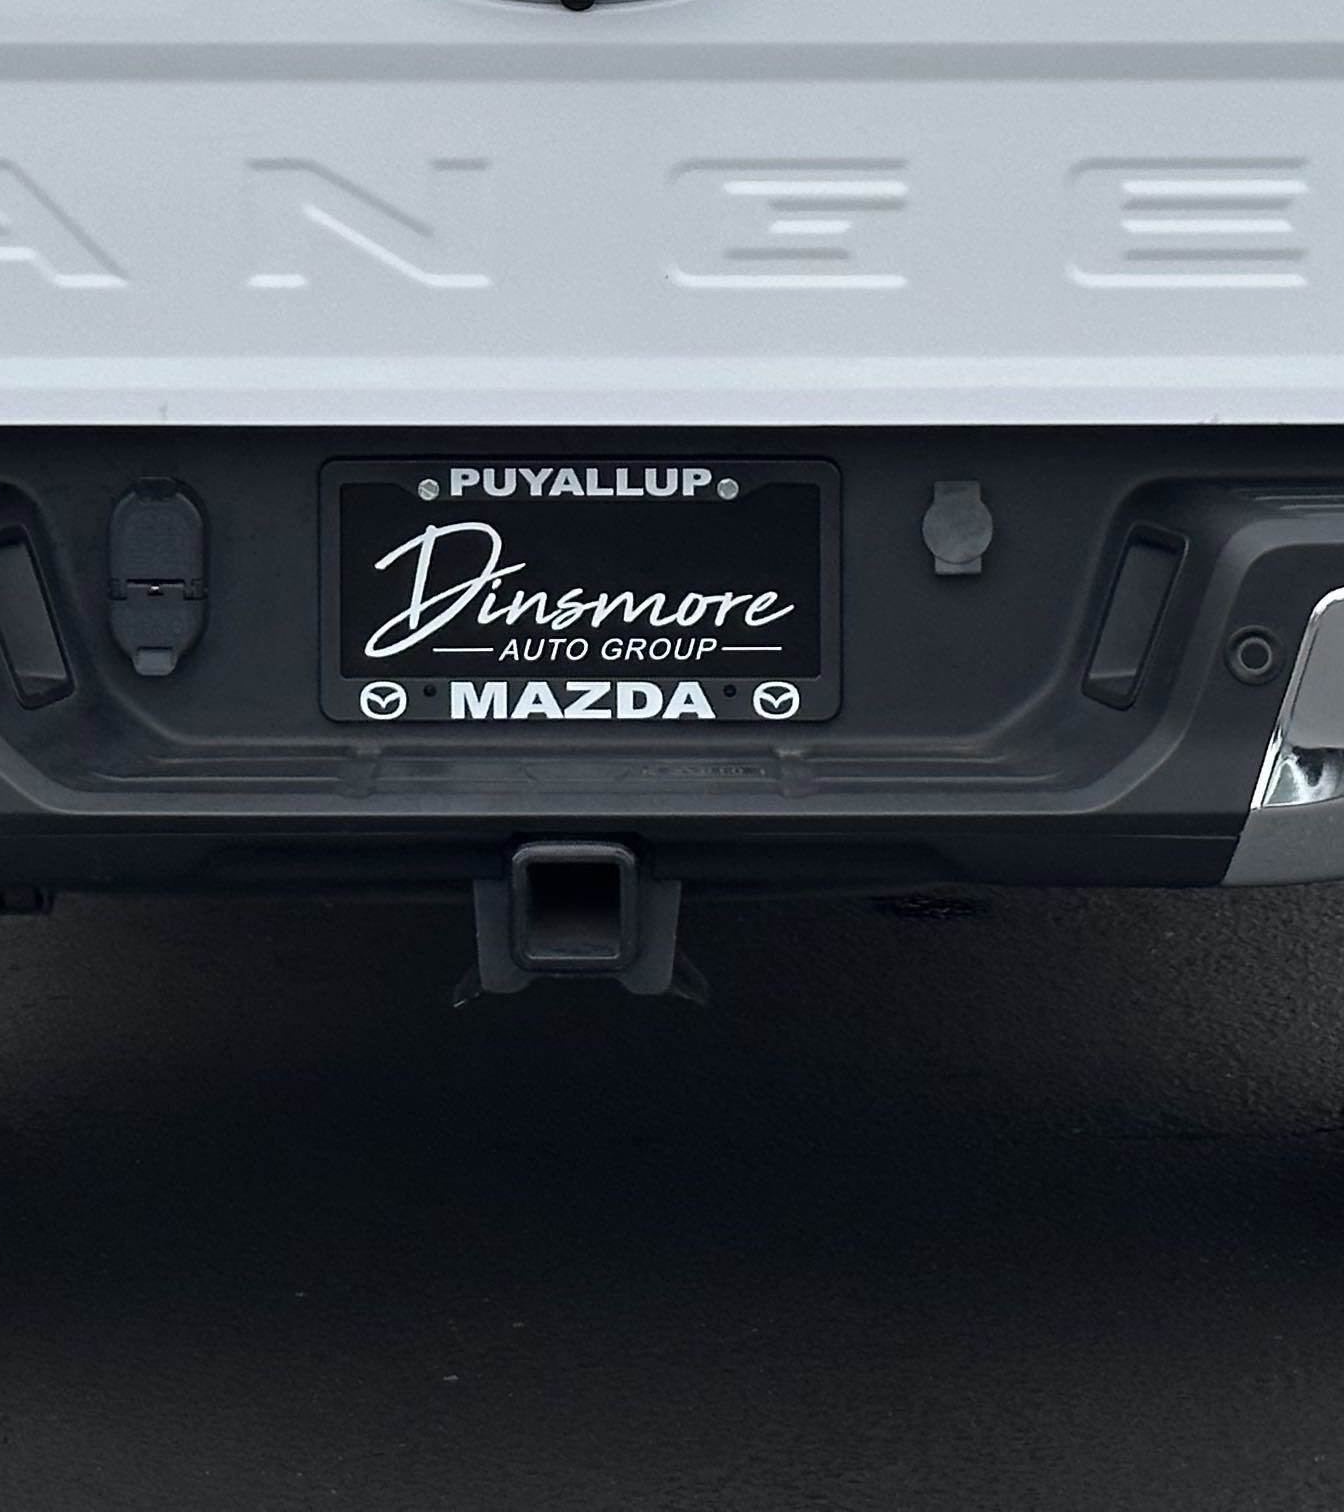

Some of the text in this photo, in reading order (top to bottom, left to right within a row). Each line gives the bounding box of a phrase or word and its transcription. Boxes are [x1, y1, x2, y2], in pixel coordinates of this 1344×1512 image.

[449, 467, 713, 498] PUYALLUP
[363, 521, 796, 659] Dinsmore
[498, 638, 718, 661] AUTO GROUP
[449, 680, 717, 720] MAZDA
